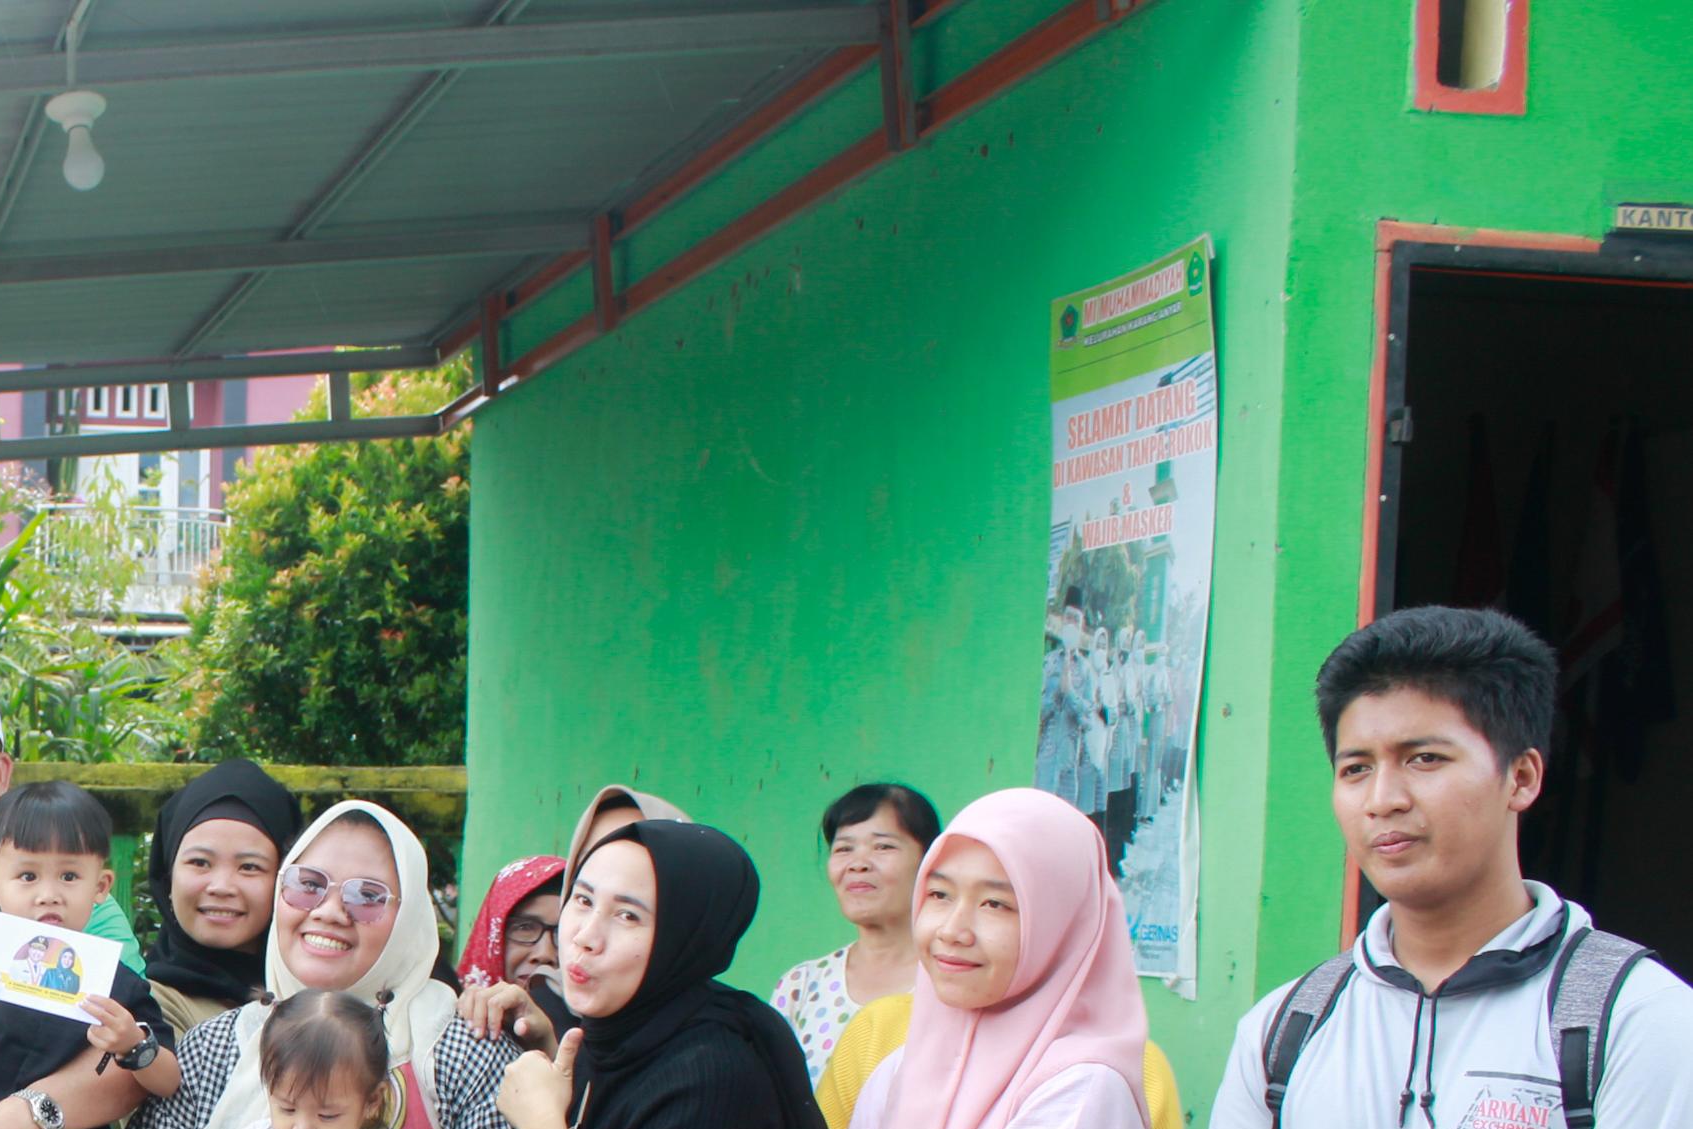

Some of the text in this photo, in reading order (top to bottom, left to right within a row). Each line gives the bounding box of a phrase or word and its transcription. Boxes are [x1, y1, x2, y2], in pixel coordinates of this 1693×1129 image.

[1621, 208, 1693, 228] KANT
[1067, 379, 1196, 449] SELAMAT DATANG
[1054, 420, 1213, 488] DI KAWASAN TANPA ROKOK
[1122, 482, 1131, 505] &
[1082, 504, 1173, 549] WAJIB MASKER
[1476, 1099, 1549, 1127] ARMANI
